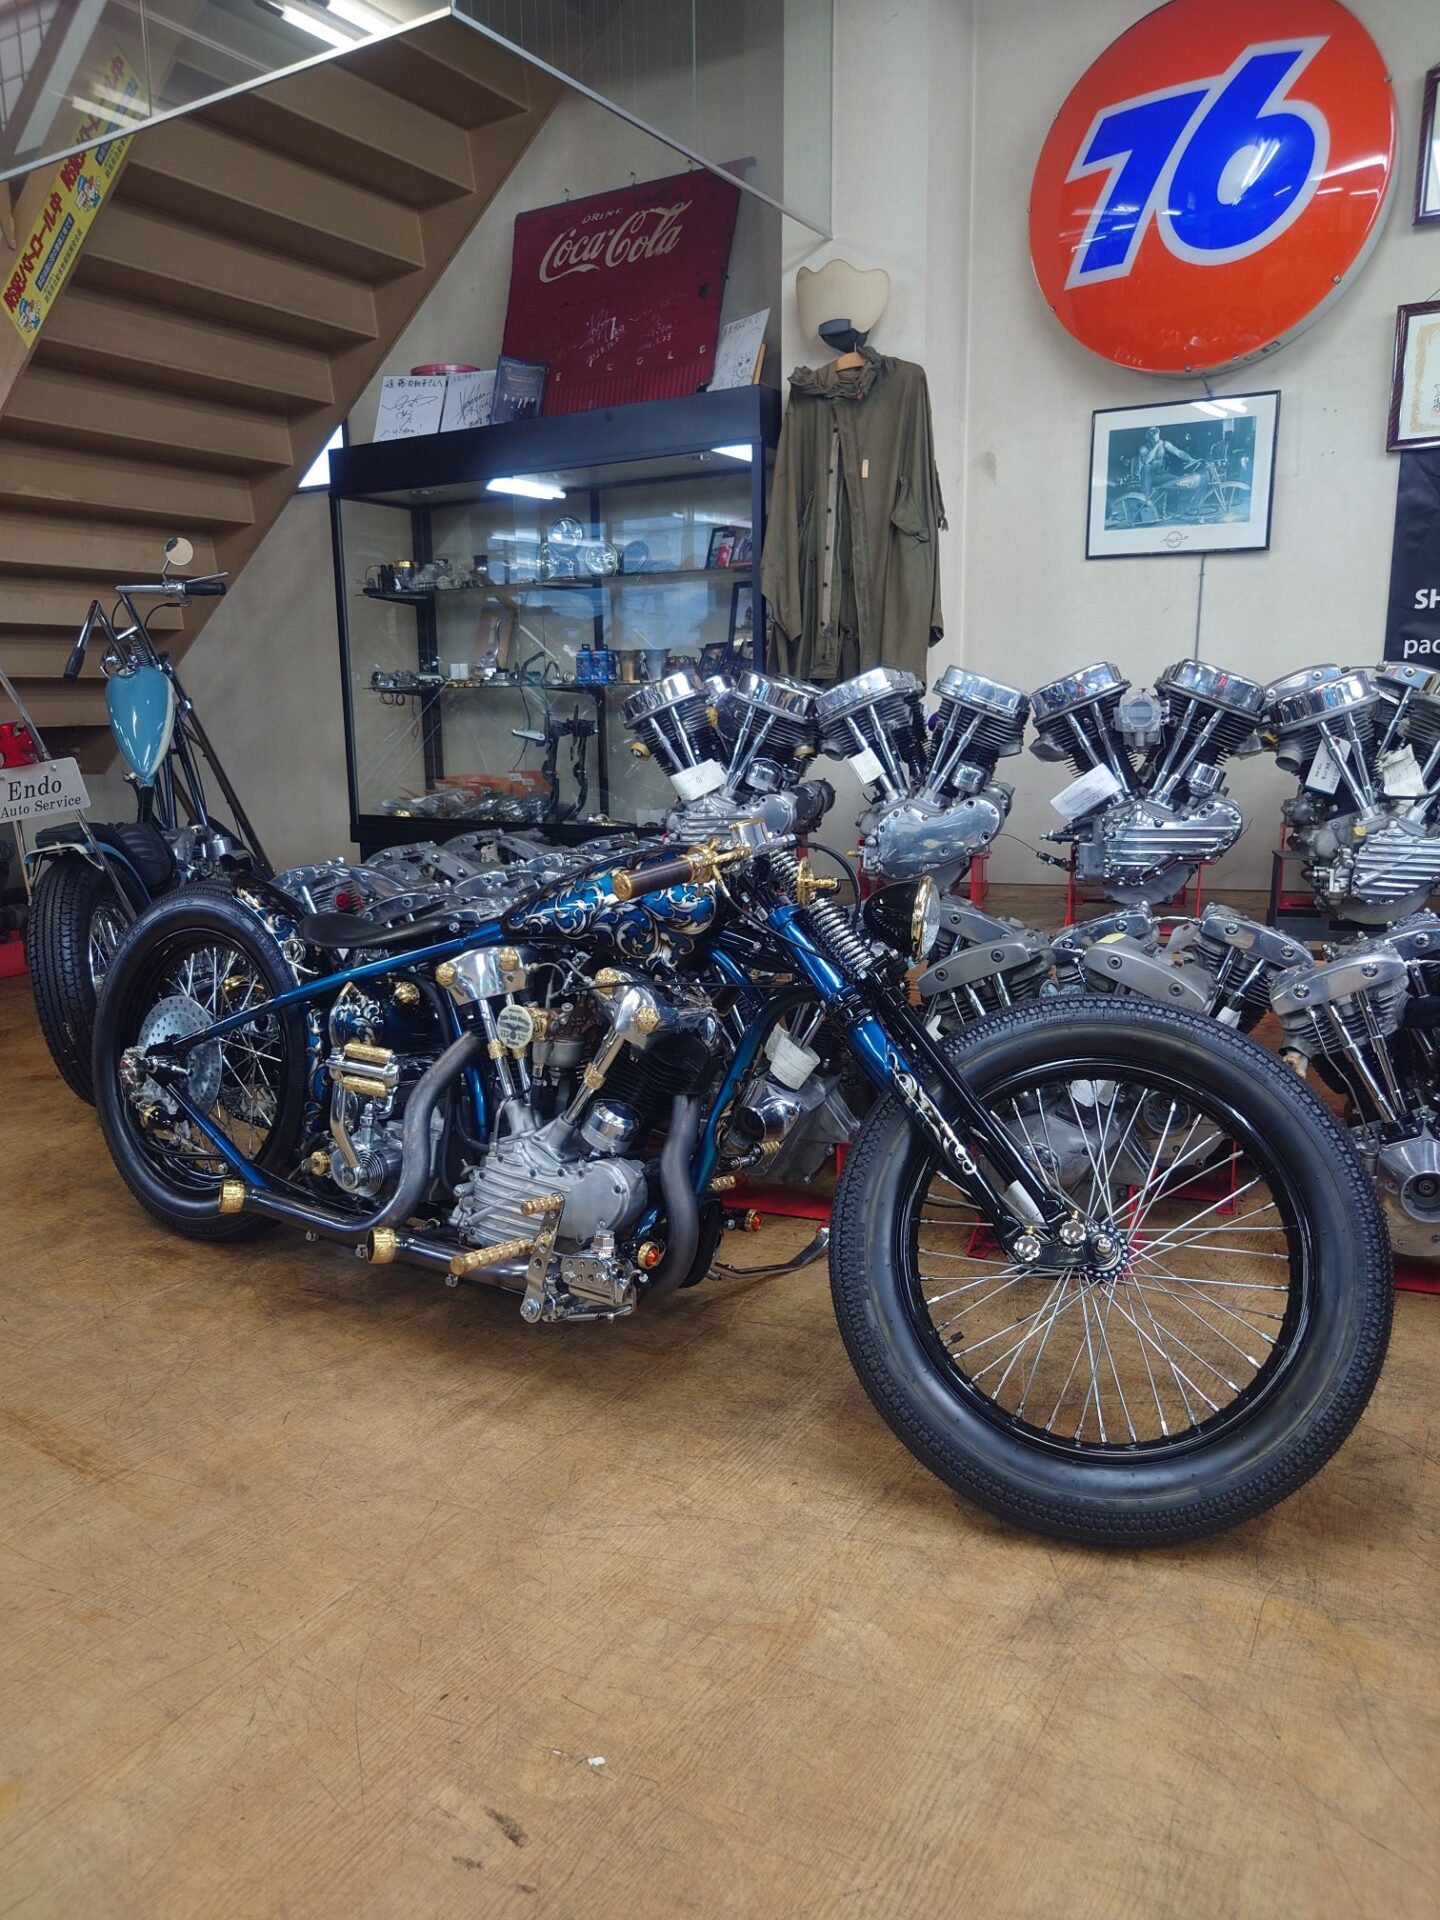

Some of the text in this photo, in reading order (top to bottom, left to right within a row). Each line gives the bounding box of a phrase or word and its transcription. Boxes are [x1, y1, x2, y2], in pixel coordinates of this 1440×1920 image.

[1065, 34, 1331, 290] 76
[3, 191, 63, 314] 防犯パトロール中
[0, 795, 82, 819] Auto Service
[7, 775, 62, 802] Endo
